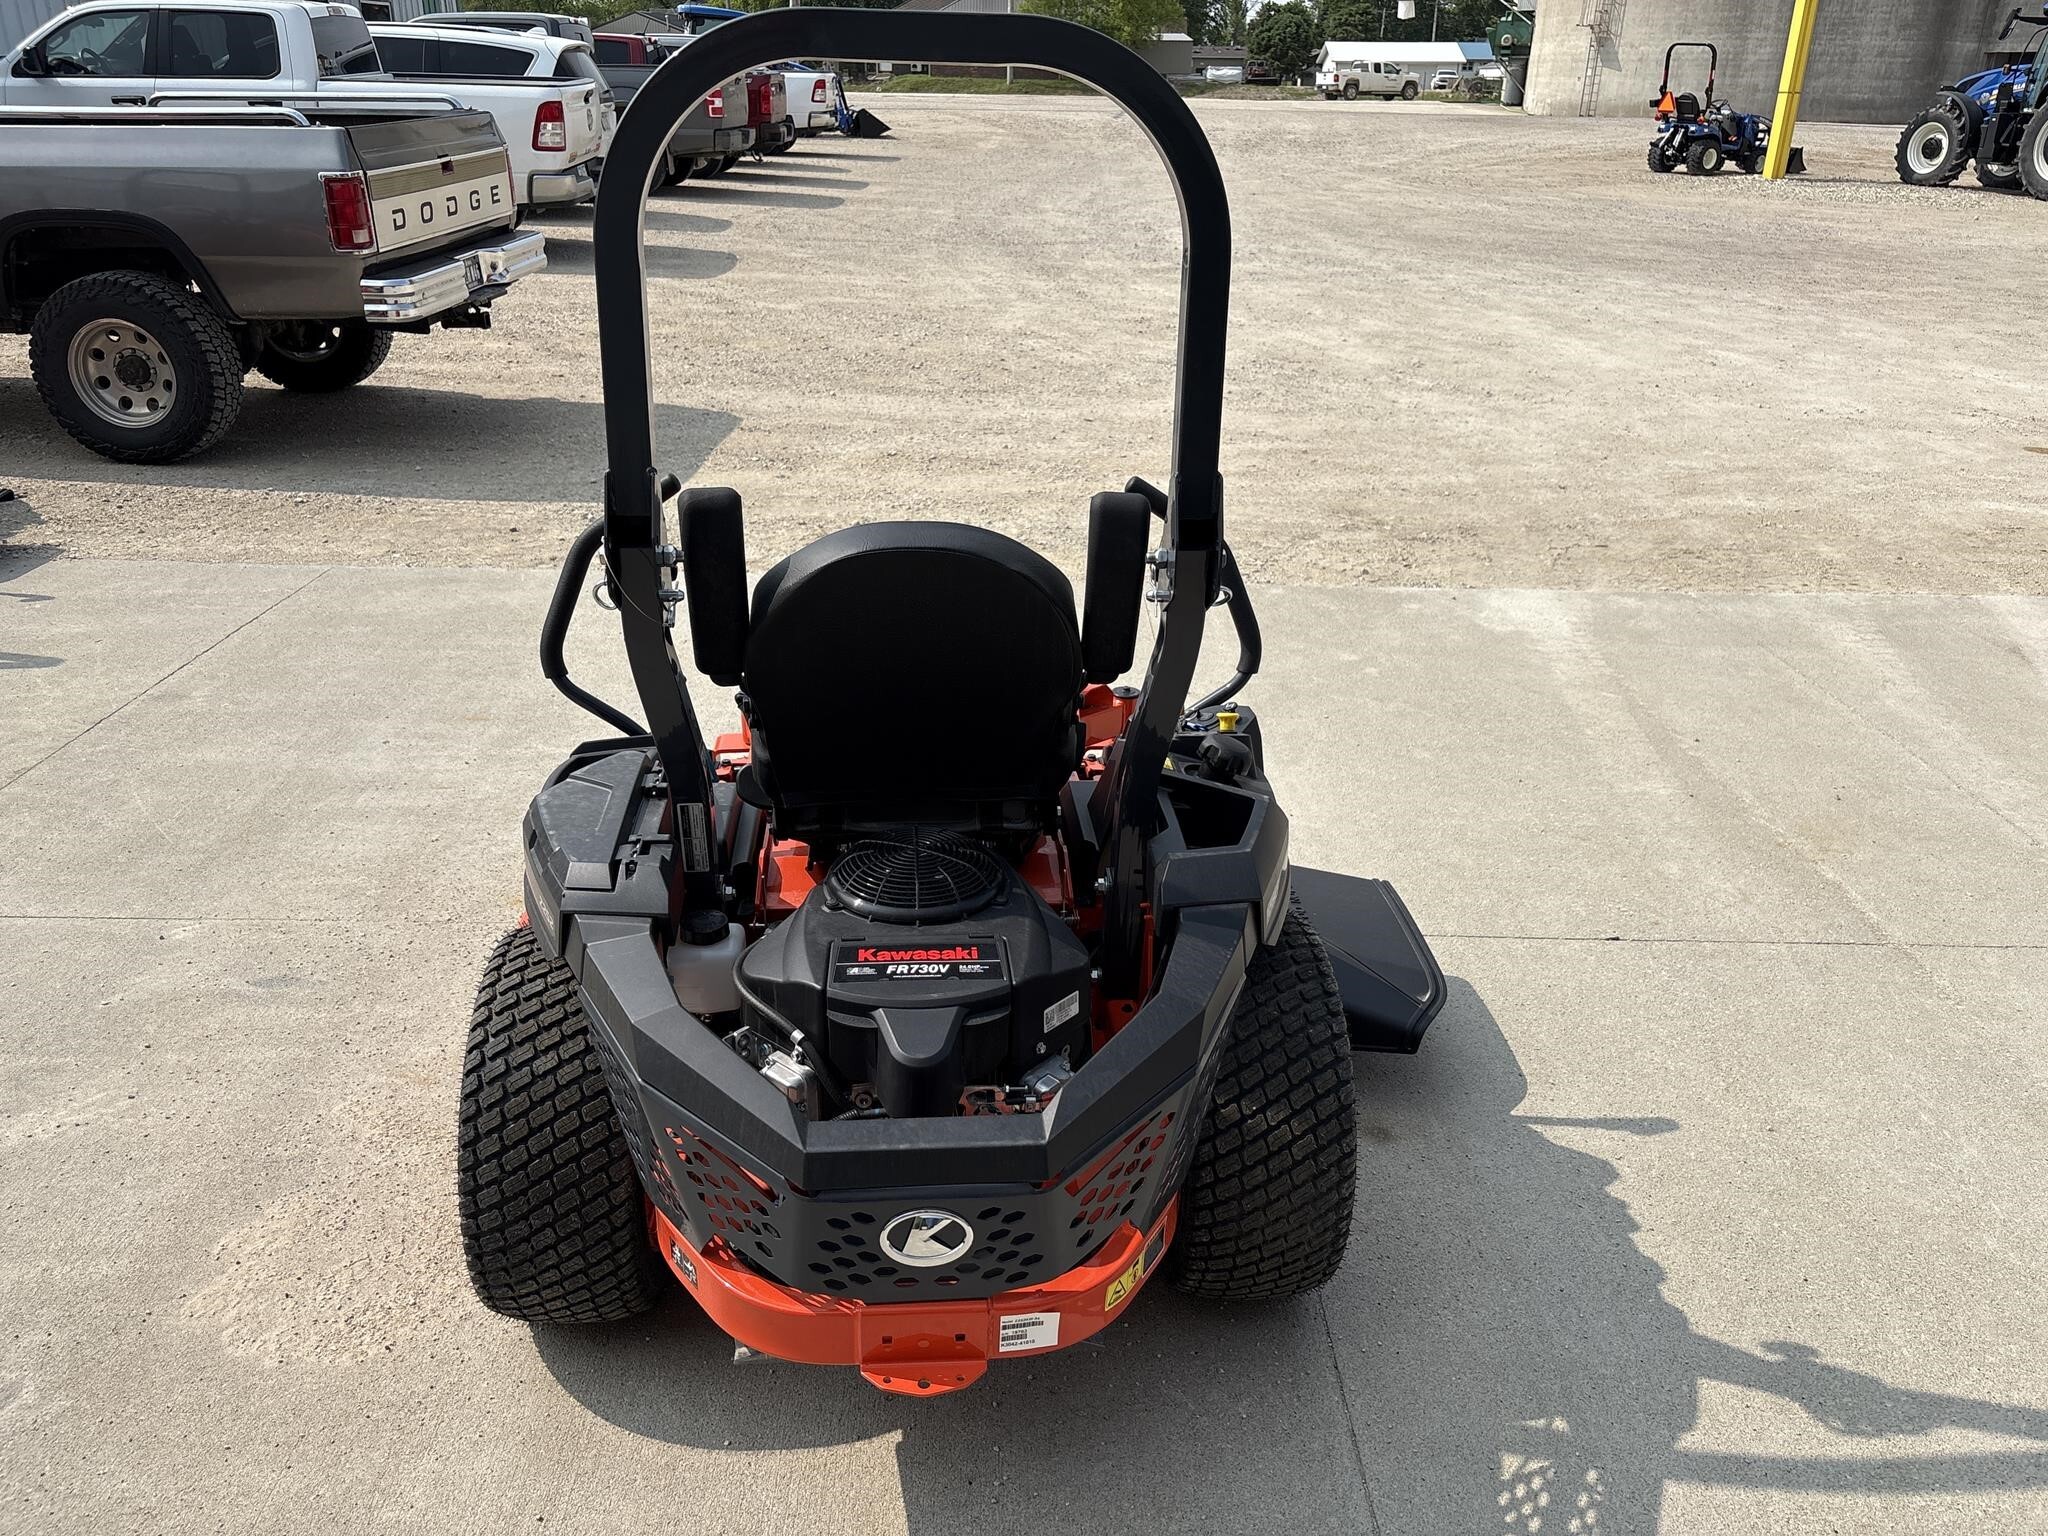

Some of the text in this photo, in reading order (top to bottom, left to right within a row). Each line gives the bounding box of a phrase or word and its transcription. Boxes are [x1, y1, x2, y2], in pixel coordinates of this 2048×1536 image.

[392, 185, 500, 231] DODGE
[858, 947, 978, 962] Kawasaki
[886, 964, 950, 974] FR730V
